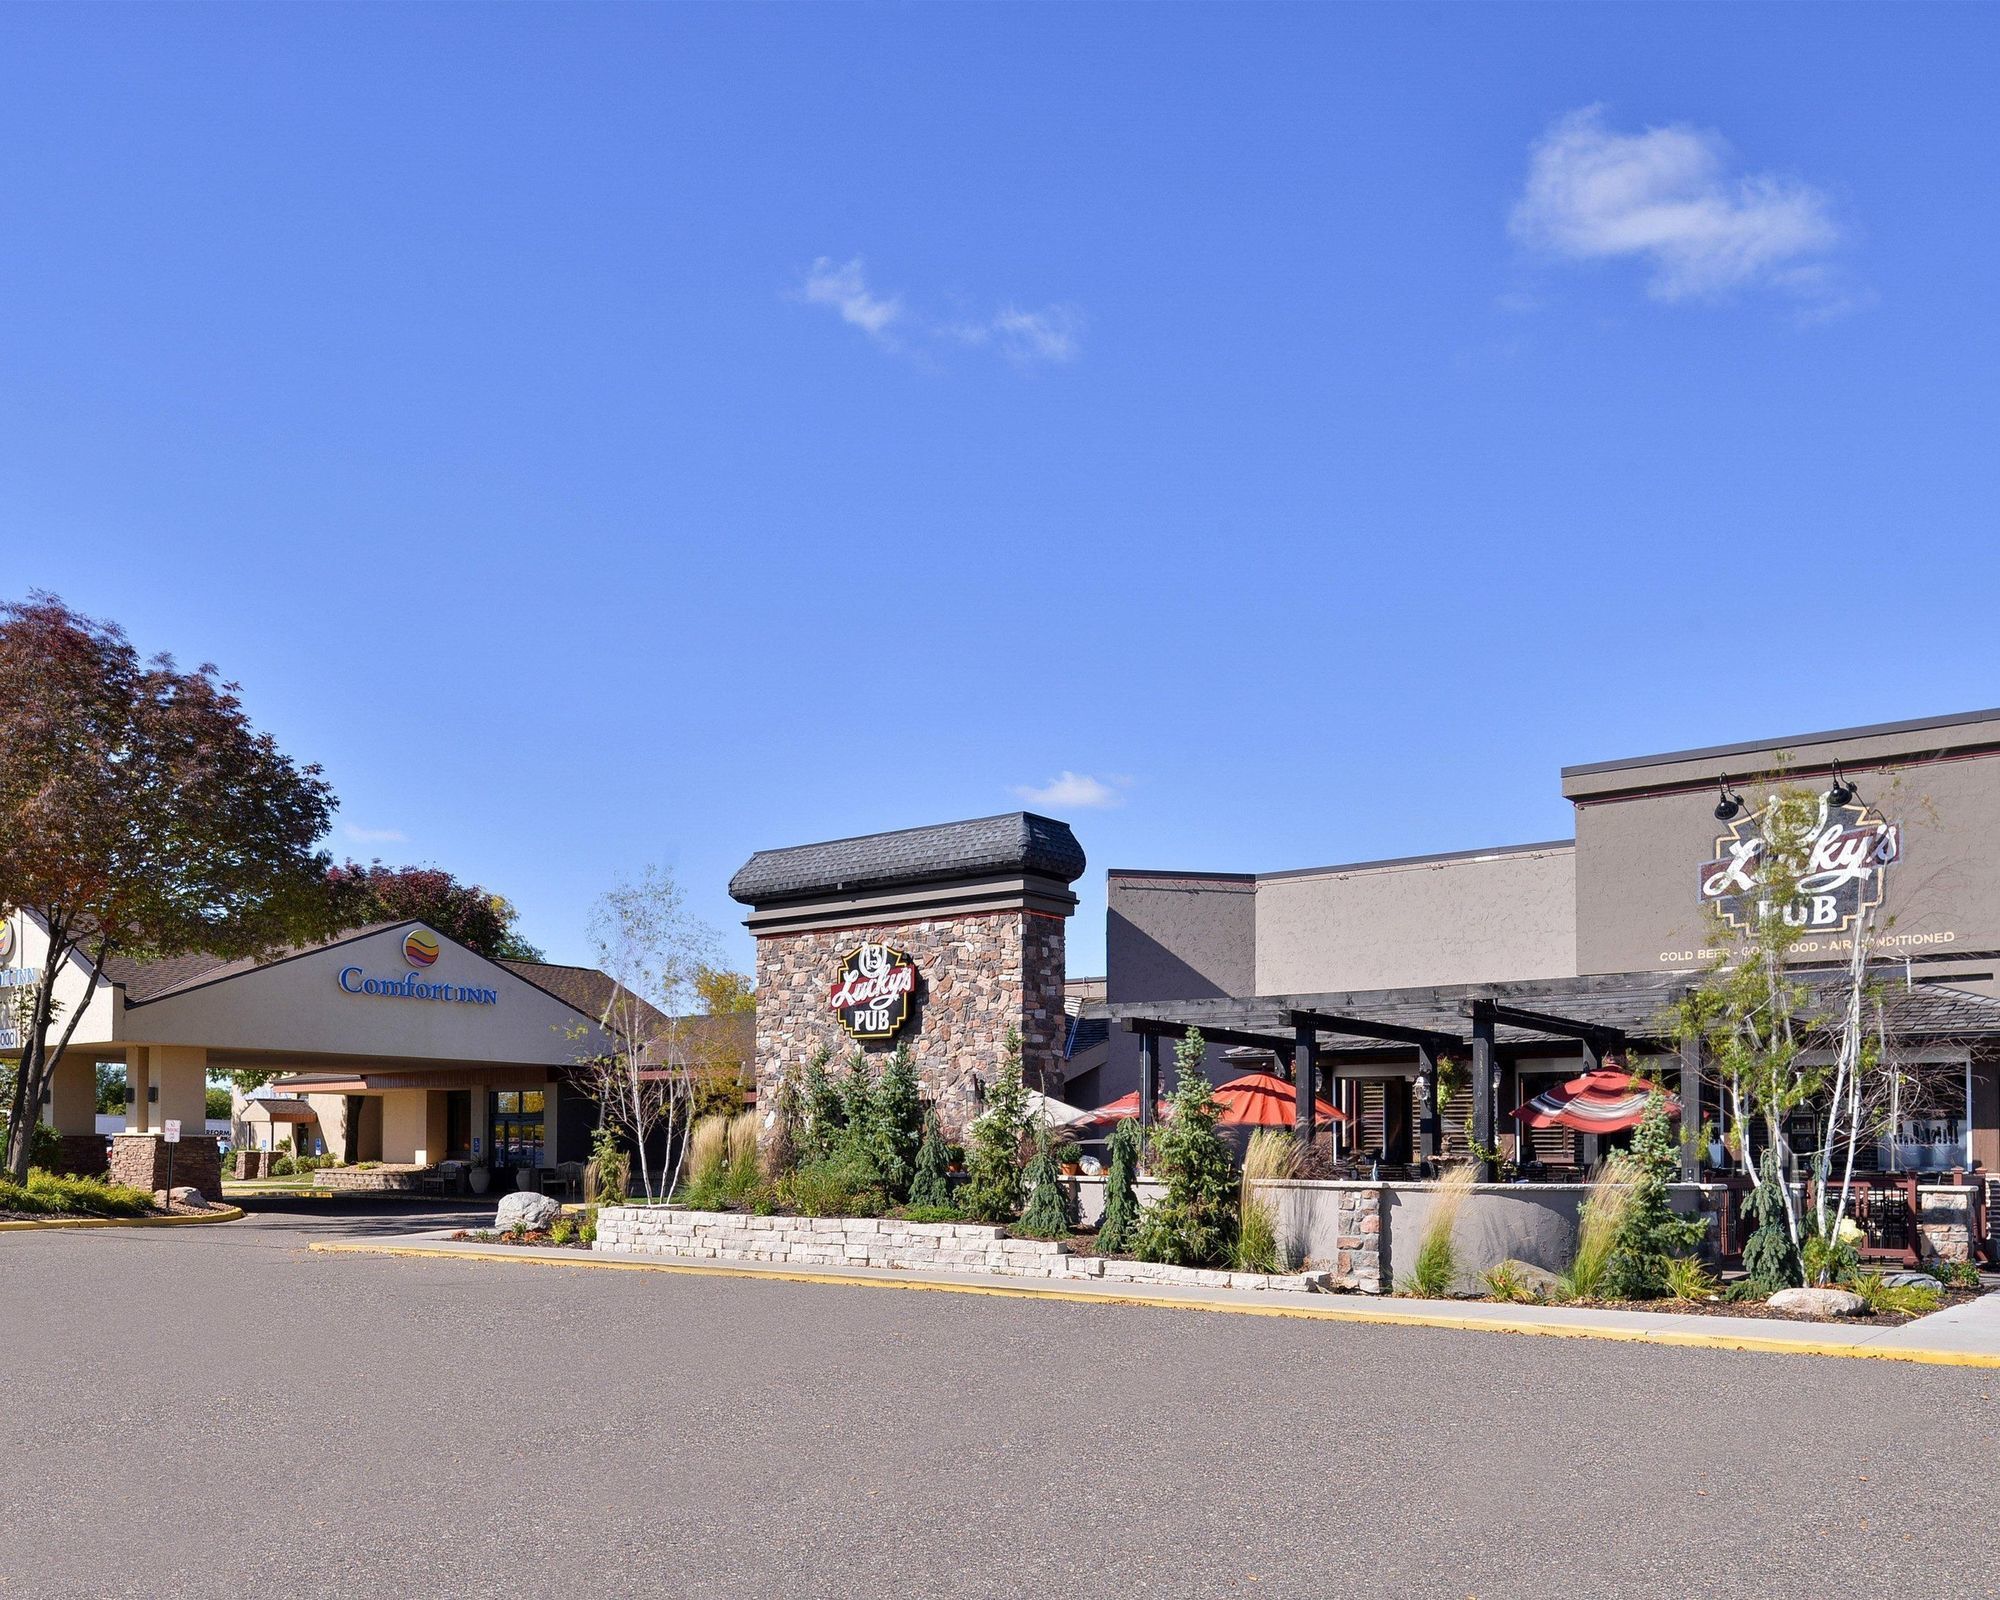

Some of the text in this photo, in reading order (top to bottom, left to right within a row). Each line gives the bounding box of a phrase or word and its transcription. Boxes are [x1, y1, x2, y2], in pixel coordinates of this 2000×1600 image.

[1660, 950, 1693, 962] COLD
[1697, 947, 1731, 959] BEER
[1786, 939, 1818, 953] OOD
[1829, 940, 1853, 951] AIR
[338, 966, 498, 1005] Comfort INN
[831, 963, 912, 1010] Lucky's
[854, 1009, 890, 1031] PUB
